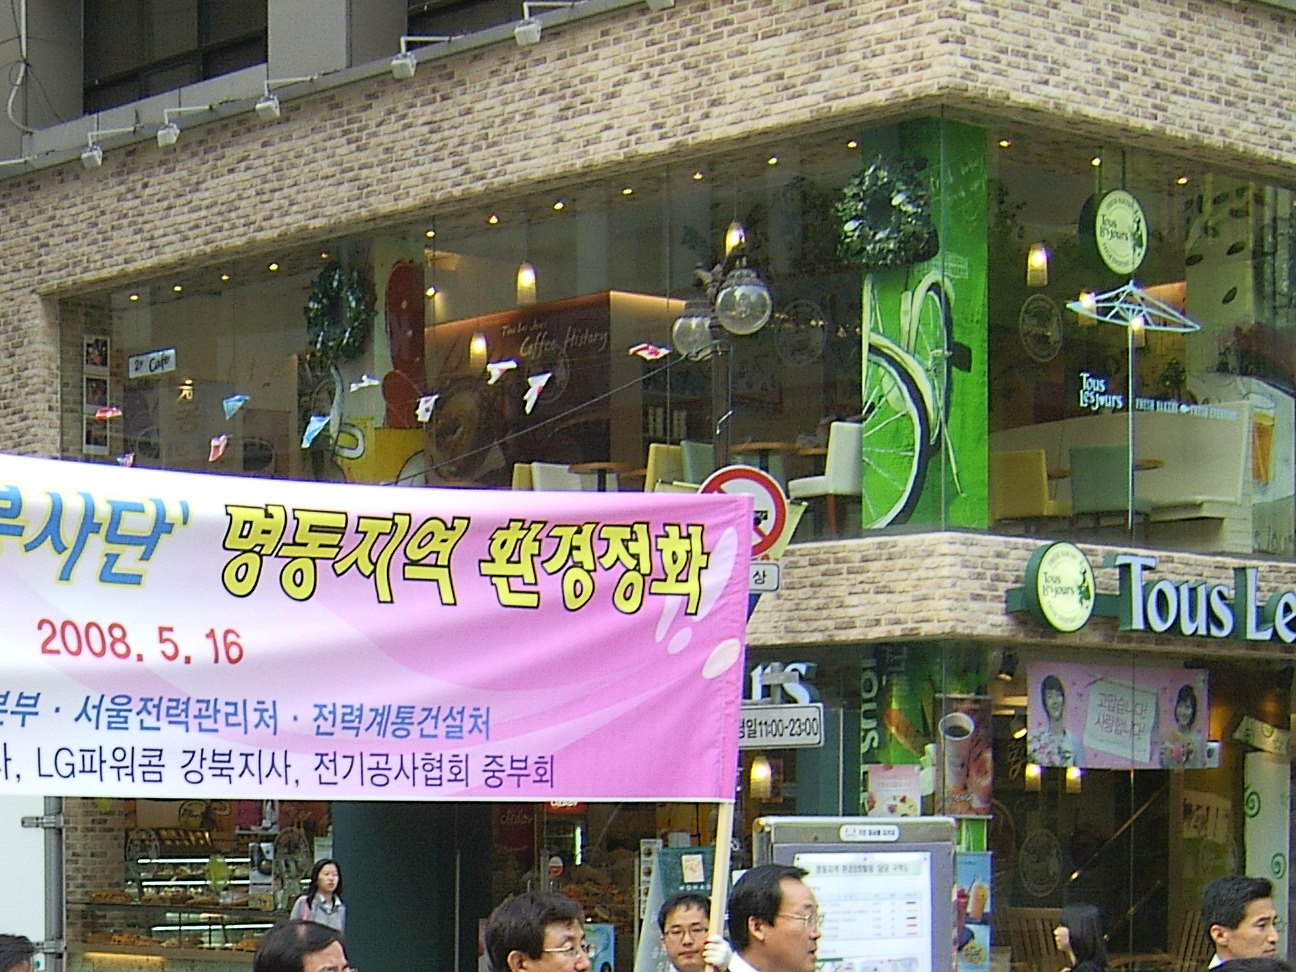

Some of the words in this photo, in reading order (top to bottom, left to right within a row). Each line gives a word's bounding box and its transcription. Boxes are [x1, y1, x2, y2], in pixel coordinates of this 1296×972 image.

[1079, 372, 1106, 392] Tous
[221, 503, 471, 606] 명동지역
[479, 518, 710, 616] 환경정화
[1115, 554, 1236, 639] Tous
[73, 693, 280, 737] 서울전력관리처
[311, 701, 492, 741] 전력계통건설처
[35, 746, 167, 785] LG파워콤
[180, 748, 301, 788] 강북지사,
[313, 750, 471, 789] 전기공사협회
[481, 753, 556, 789] 중부회
